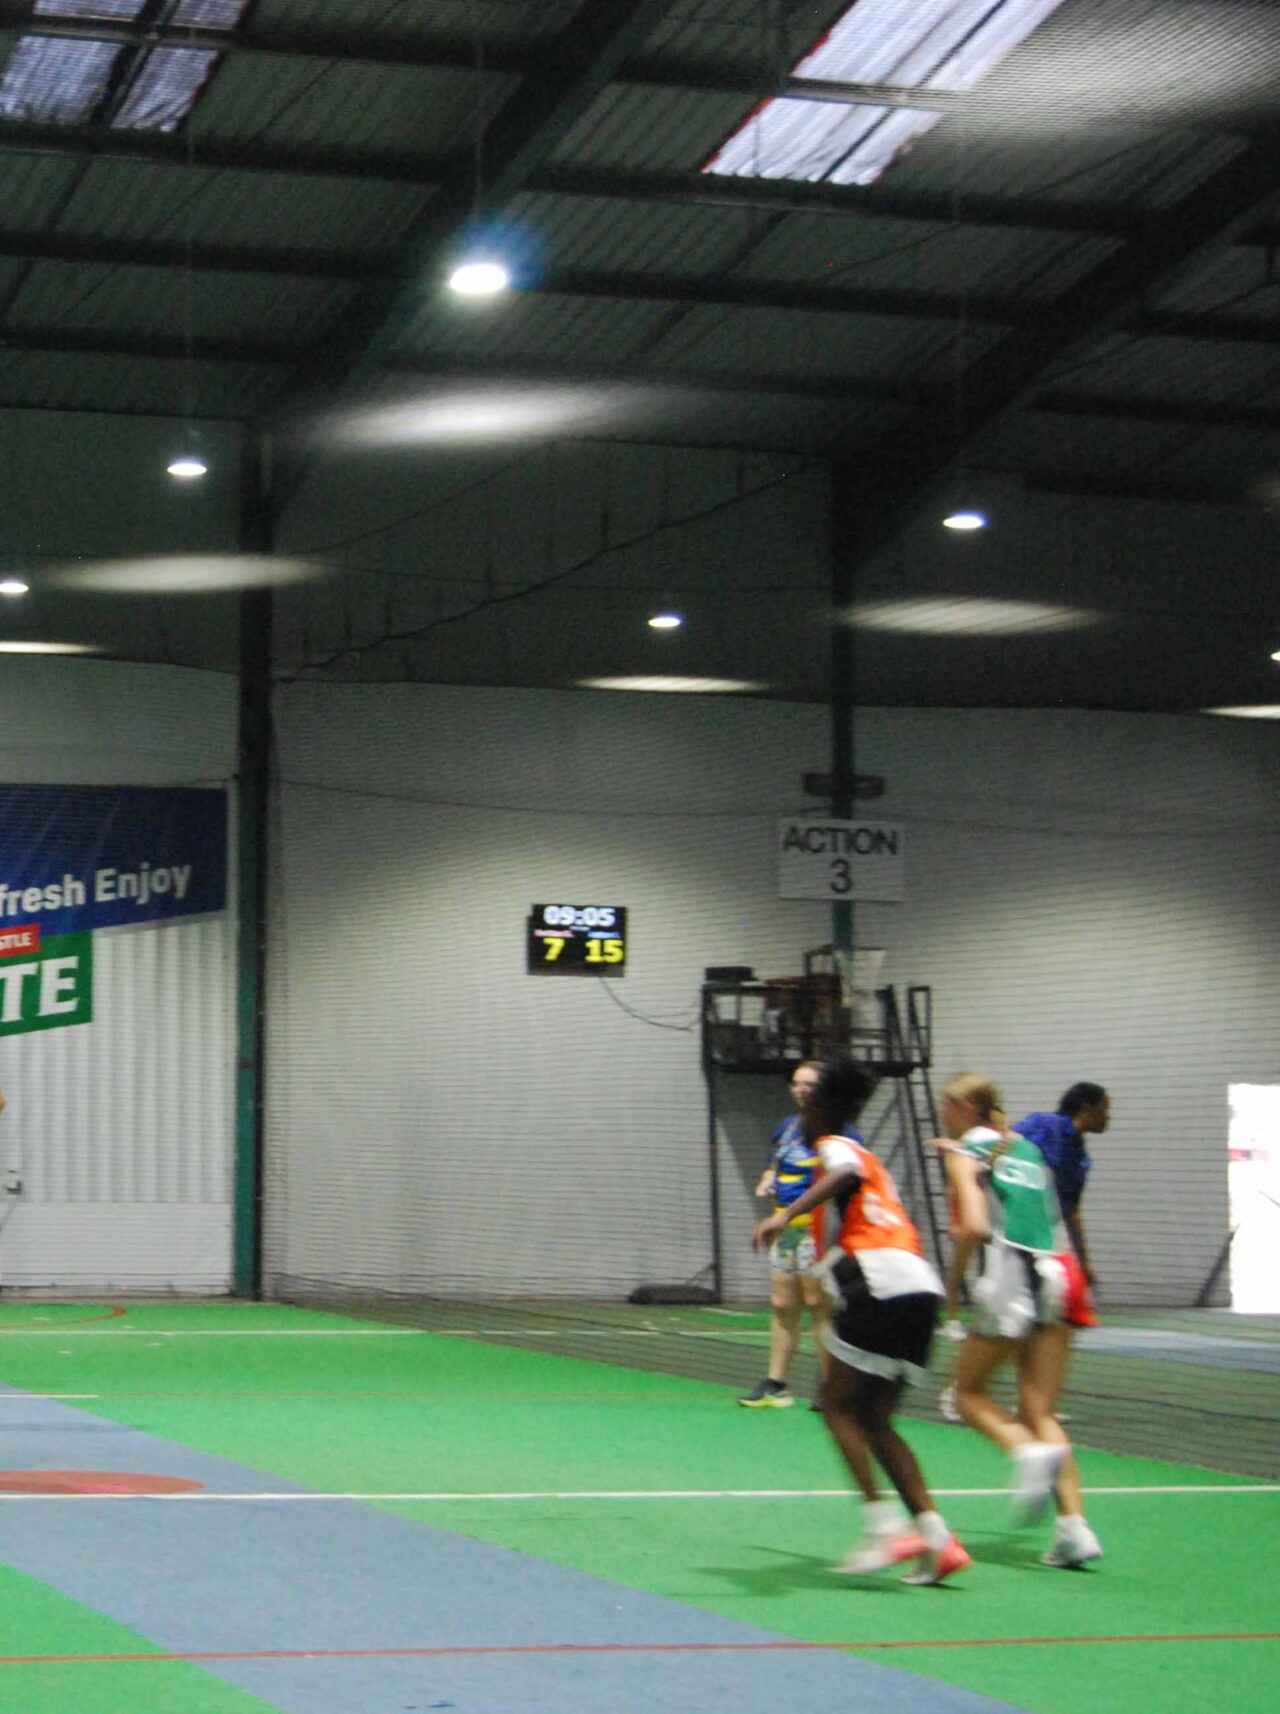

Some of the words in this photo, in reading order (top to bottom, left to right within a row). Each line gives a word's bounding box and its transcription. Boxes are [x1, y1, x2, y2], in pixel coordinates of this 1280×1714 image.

[783, 826, 898, 855] ACTION
[95, 861, 192, 905] Enjoy
[830, 859, 853, 894] 3
[543, 937, 566, 961] 7
[585, 939, 624, 963] 15
